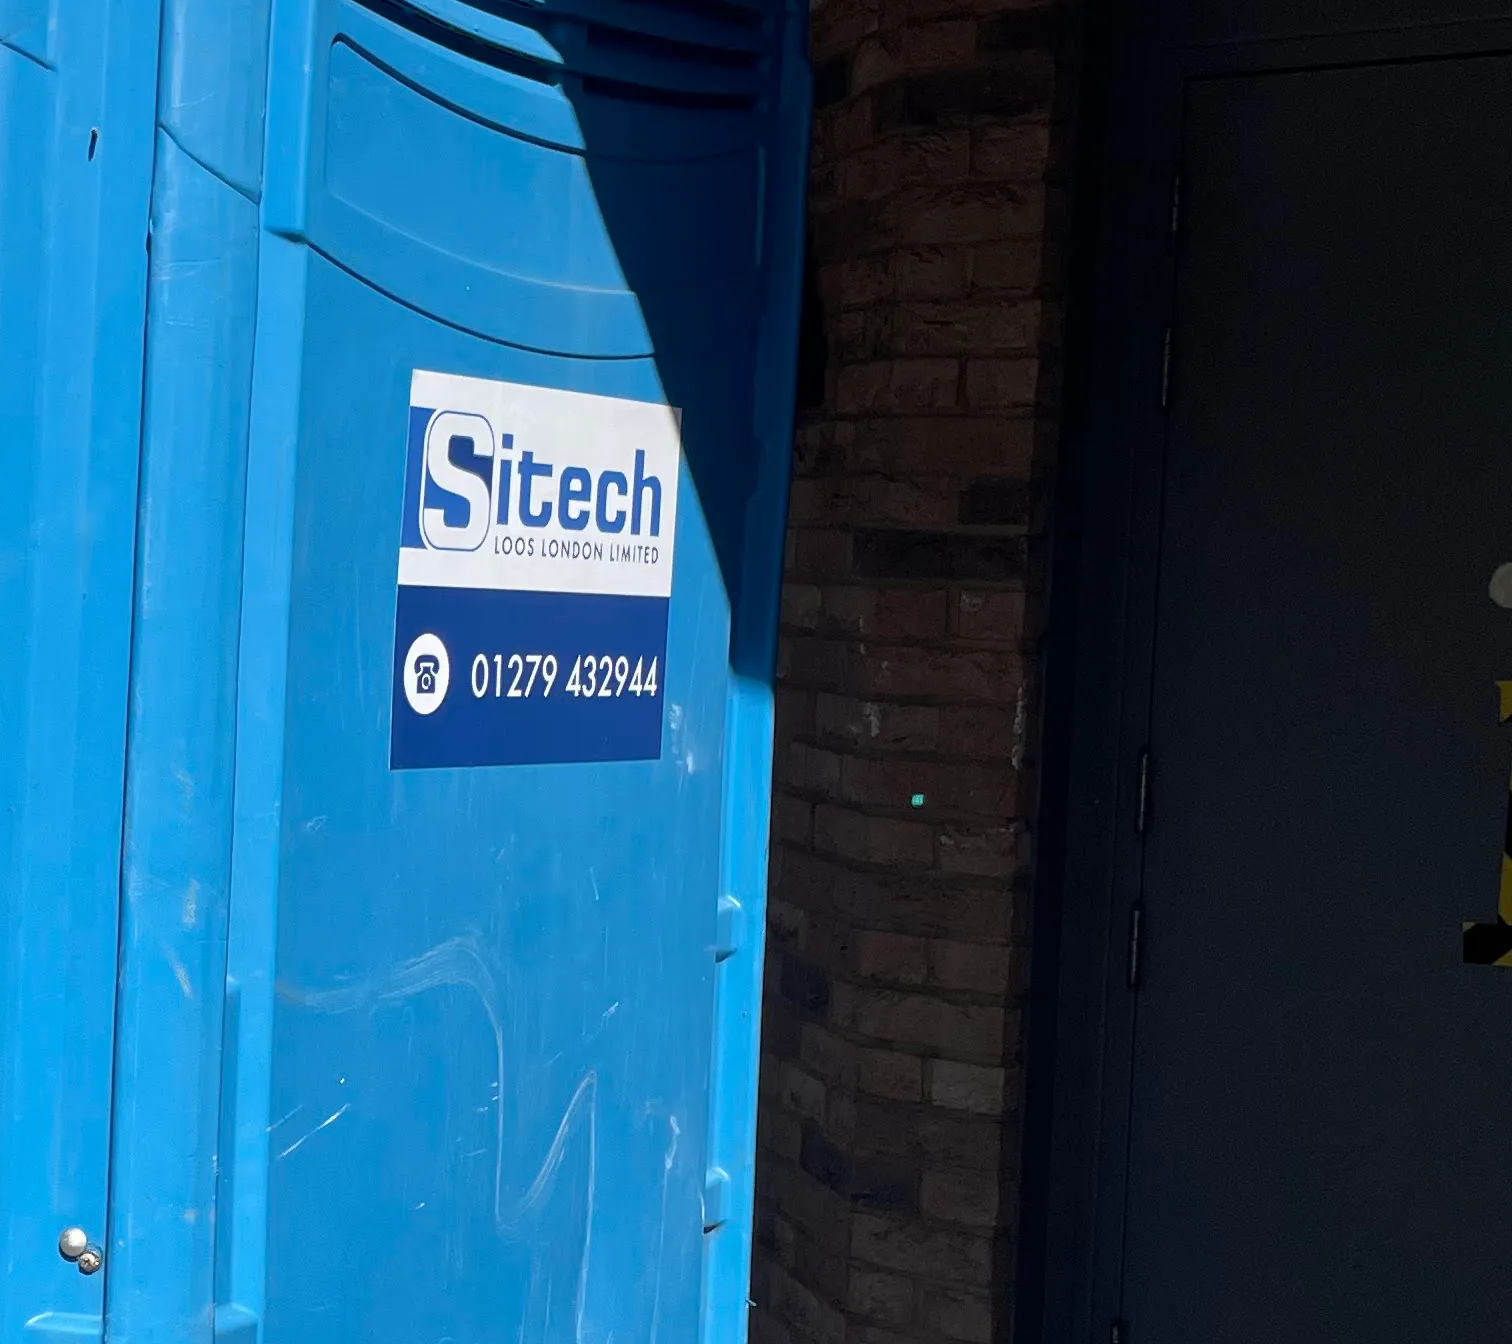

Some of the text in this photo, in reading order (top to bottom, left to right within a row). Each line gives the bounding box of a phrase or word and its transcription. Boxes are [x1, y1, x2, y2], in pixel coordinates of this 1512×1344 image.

[422, 410, 662, 553] Sitech
[493, 536, 660, 565] LOOS LONDON LIMITED
[471, 653, 658, 699] 01279 432944
